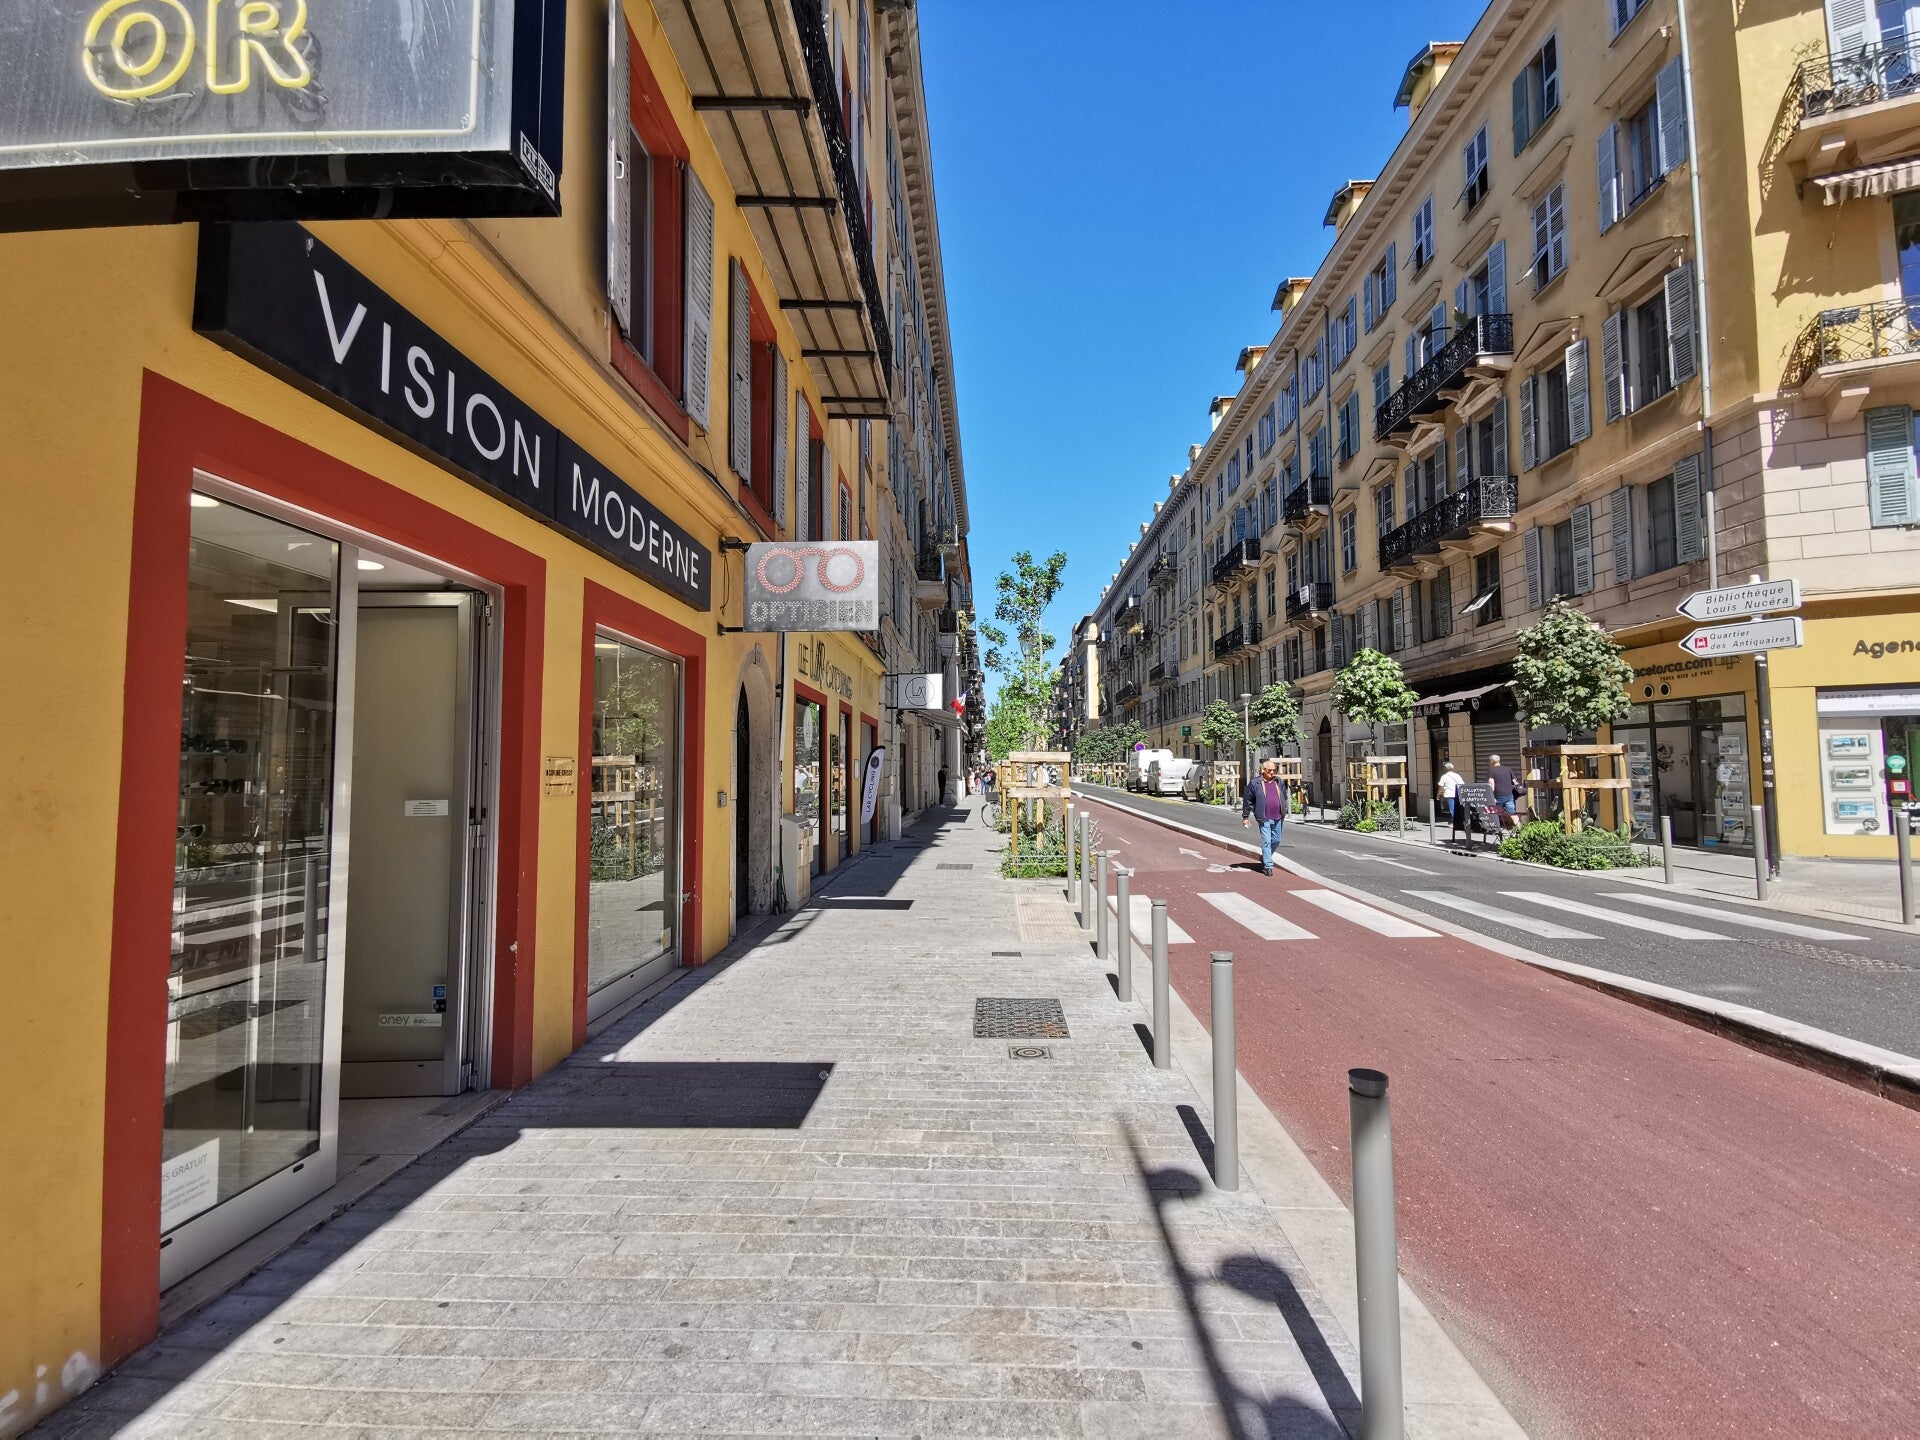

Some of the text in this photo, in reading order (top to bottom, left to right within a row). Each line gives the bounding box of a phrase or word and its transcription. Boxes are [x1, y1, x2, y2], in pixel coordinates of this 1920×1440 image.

[83, 0, 311, 98] OR
[313, 269, 700, 590] VISION MODERNE
[1705, 586, 1784, 605] Bibliothèque
[750, 600, 873, 623] OPTICIEN
[1706, 596, 1789, 615] Louis Nucéra
[1709, 629, 1750, 641] Quartier
[1710, 635, 1792, 650] des Antiquaires
[380, 1016, 410, 1026] oney
[171, 1153, 208, 1178] GRATUIT
